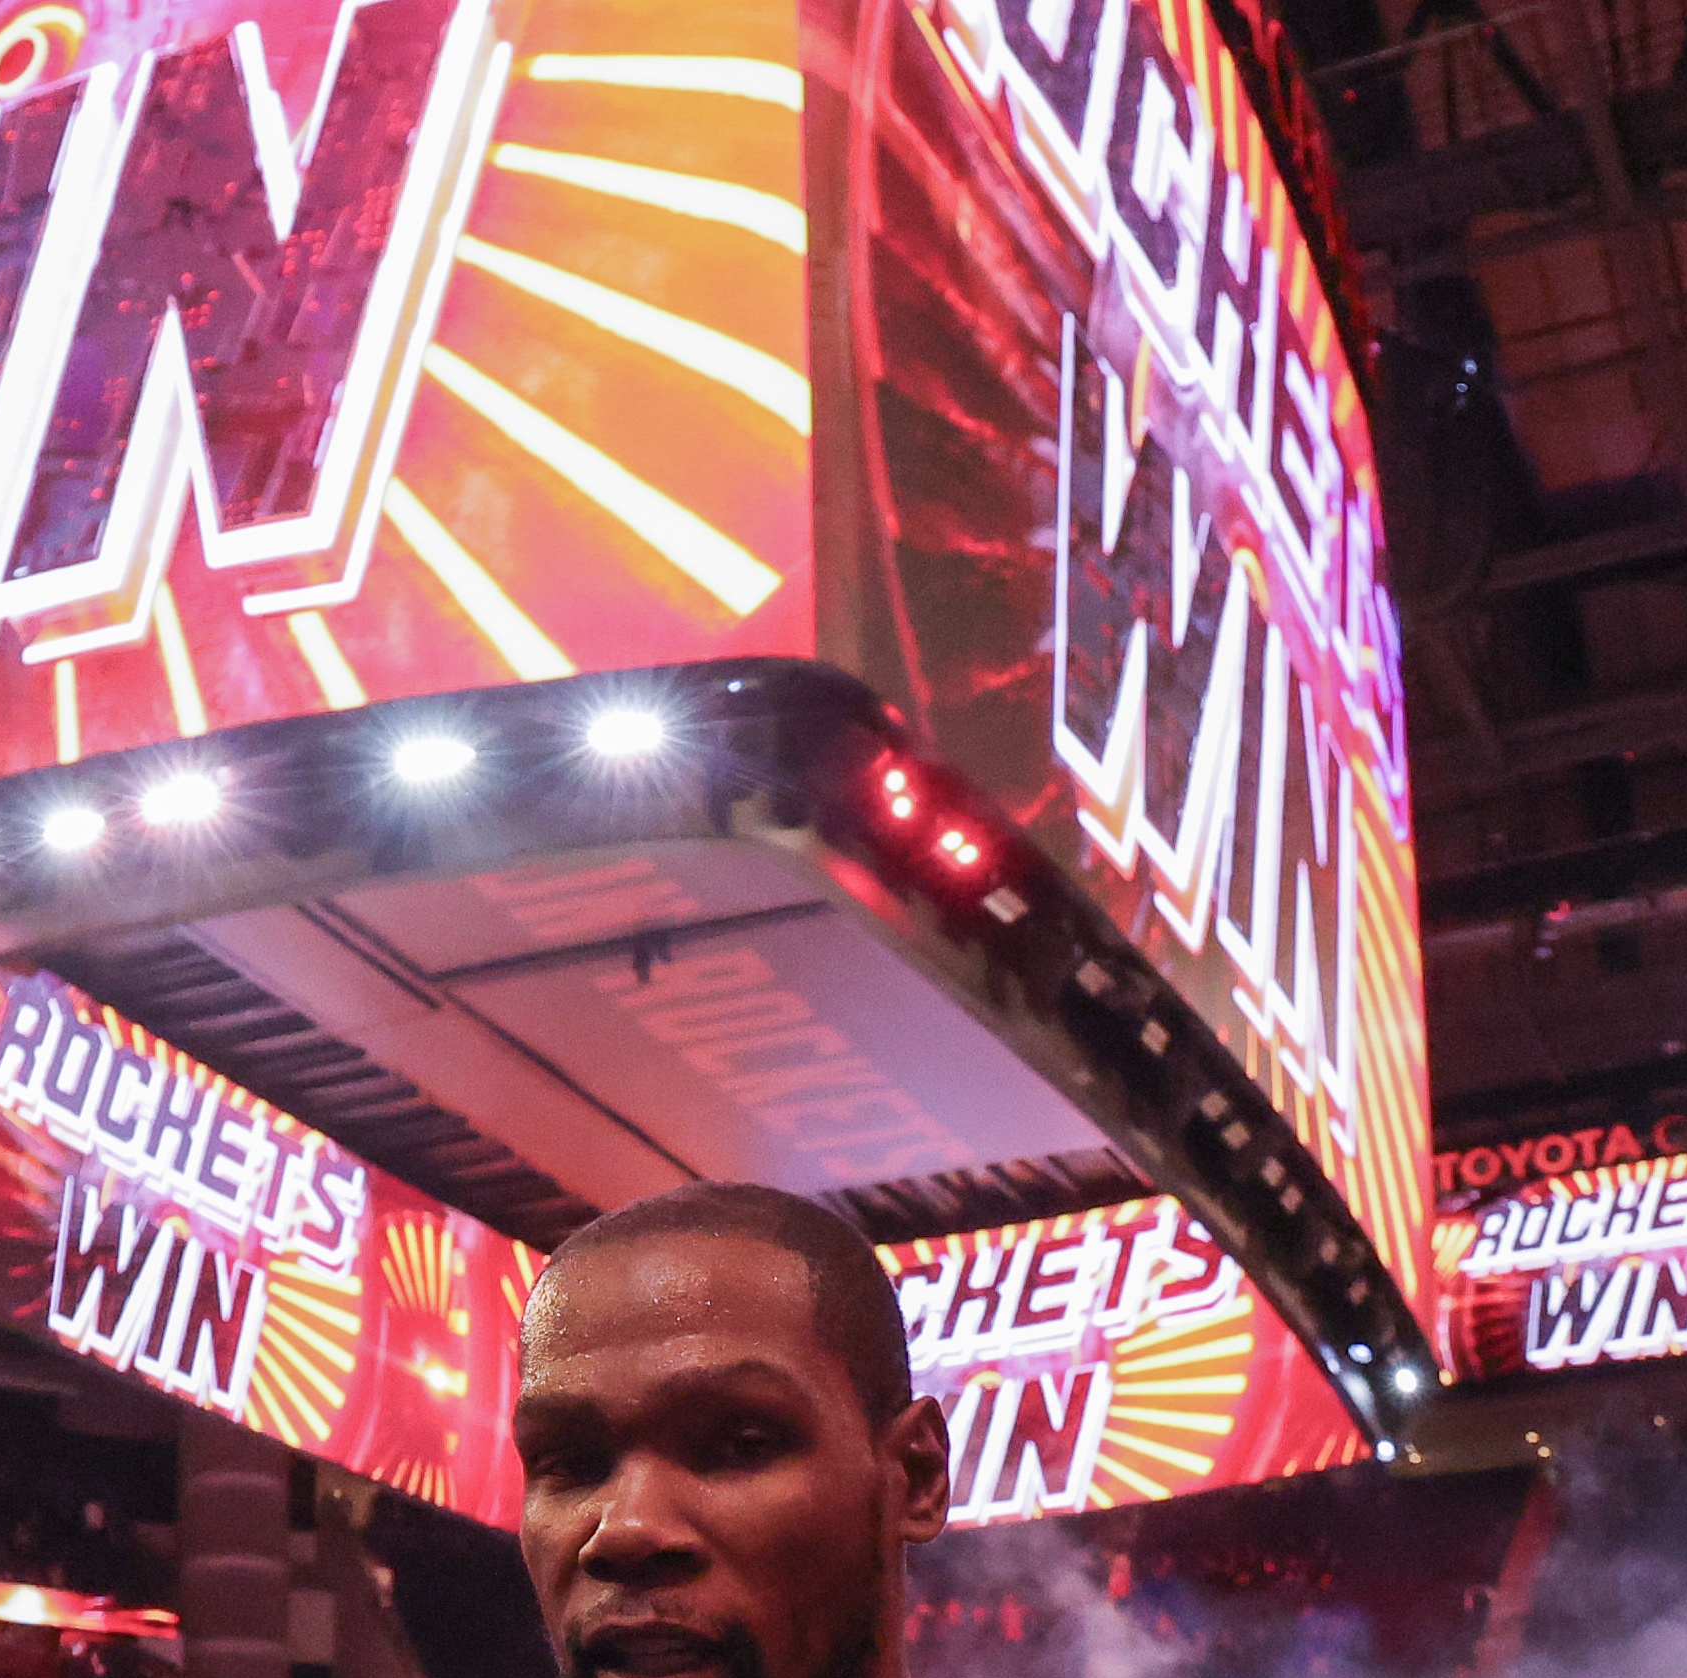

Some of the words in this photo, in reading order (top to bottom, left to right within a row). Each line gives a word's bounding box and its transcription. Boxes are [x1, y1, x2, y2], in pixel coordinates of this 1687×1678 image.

[1053, 310, 1357, 1158] WIN
[1432, 1122, 1645, 1193] TOYOTA
[49, 1172, 266, 1419] WIN
